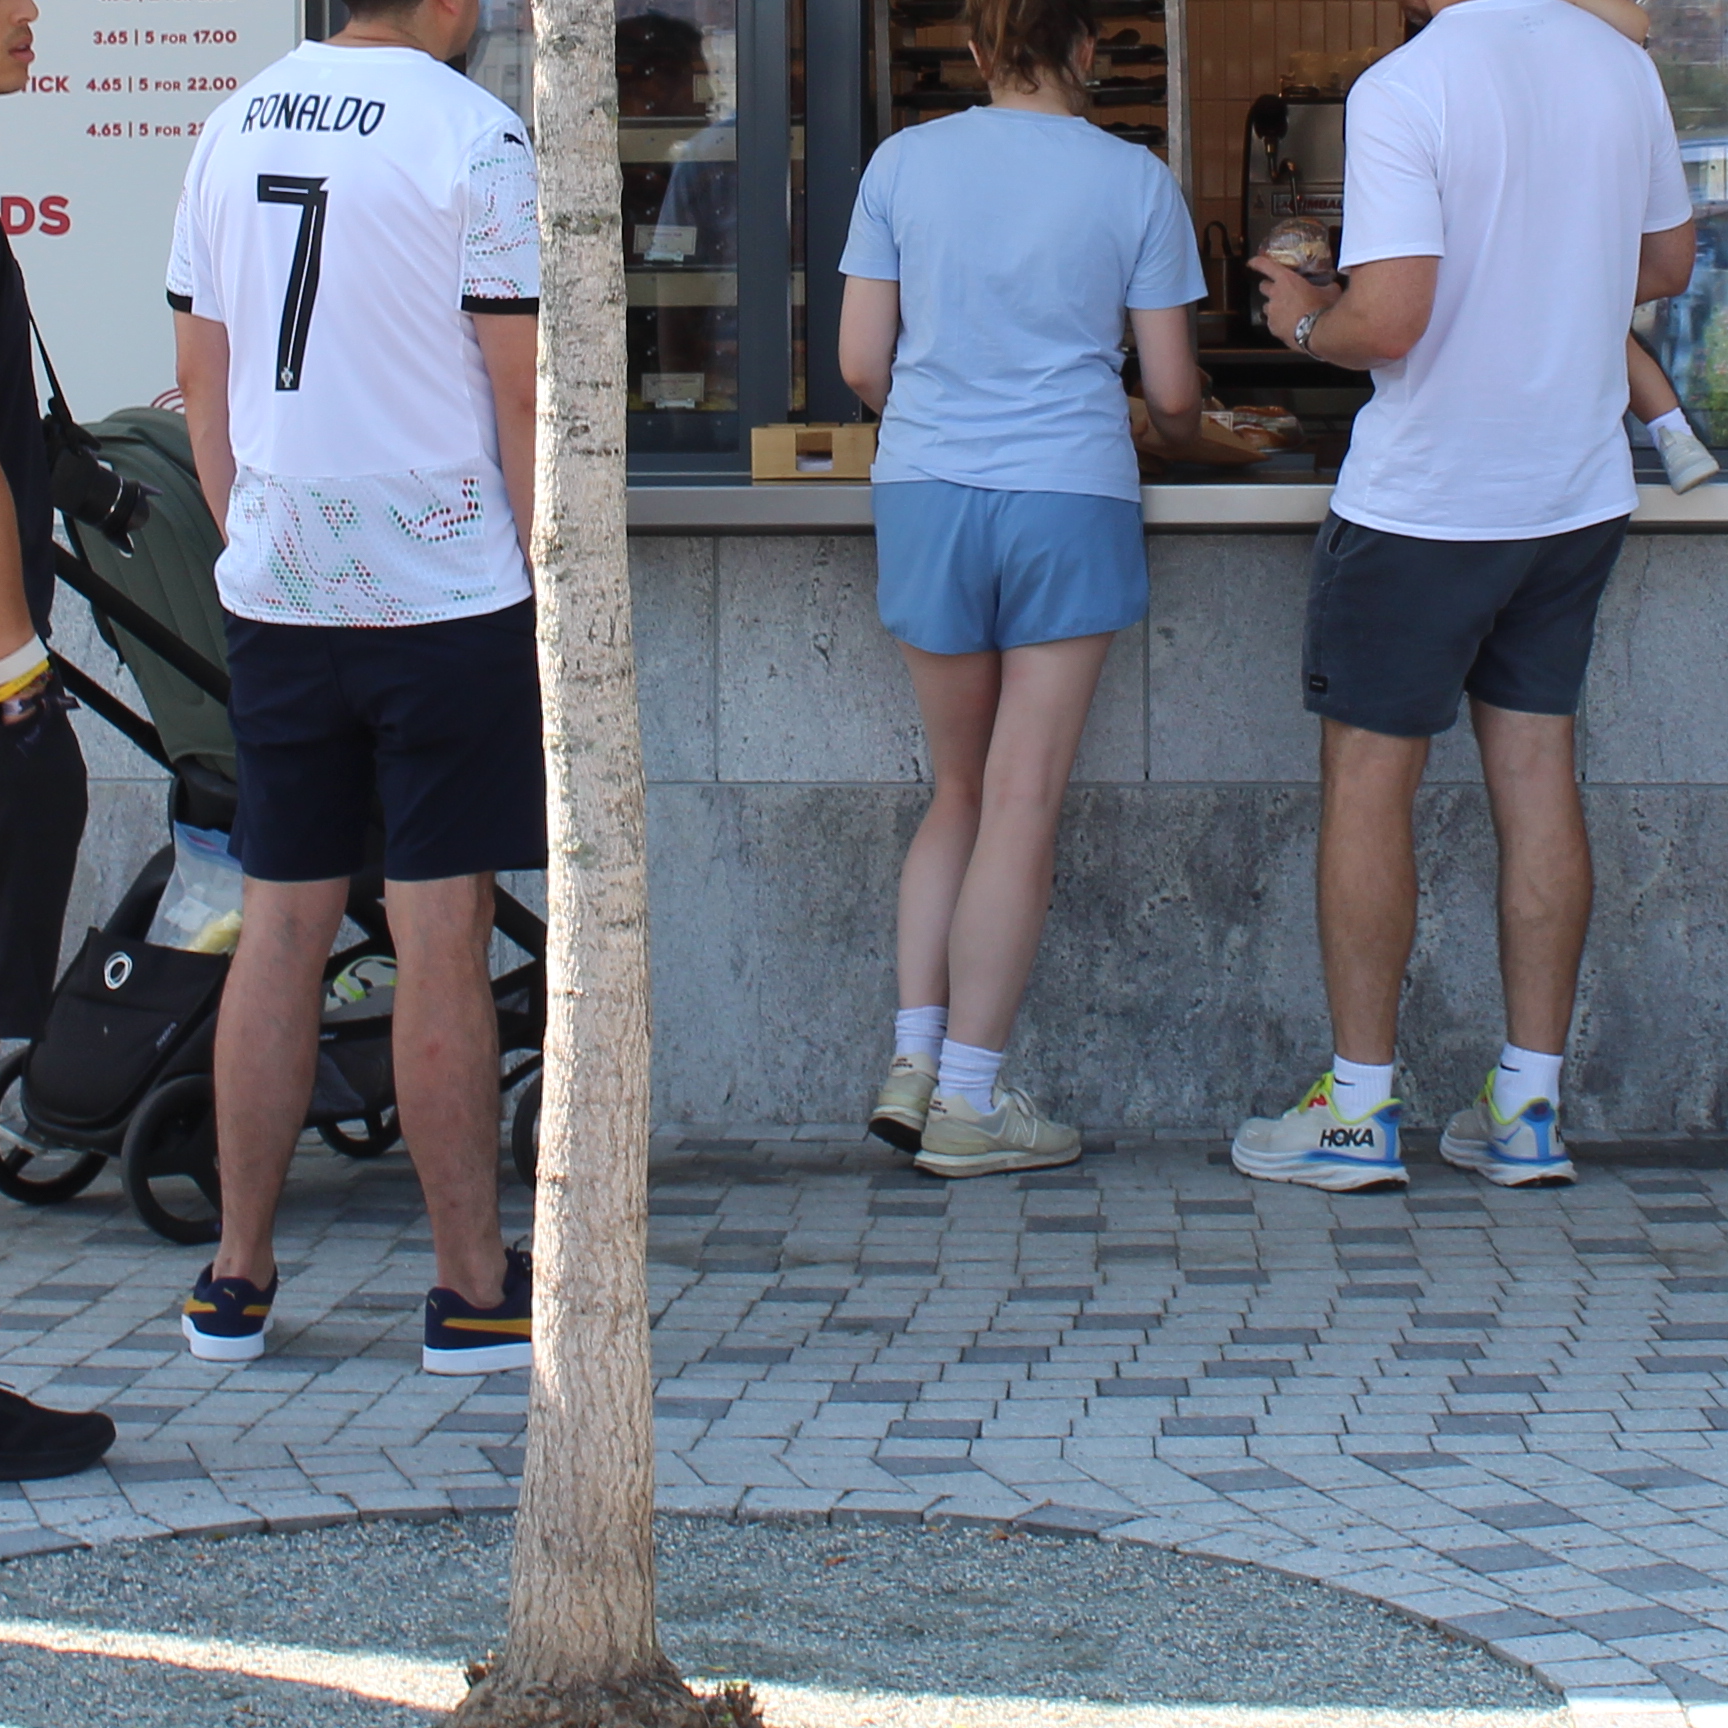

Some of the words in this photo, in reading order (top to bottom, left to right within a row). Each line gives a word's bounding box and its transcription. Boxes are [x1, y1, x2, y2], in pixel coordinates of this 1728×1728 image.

[93, 30, 128, 45] 3.65
[145, 30, 155, 45] 5
[160, 33, 187, 44] FOR
[192, 29, 237, 44] 17.00
[86, 77, 122, 92] 4.65
[138, 77, 149, 92] 5
[154, 80, 181, 92] FOR
[187, 76, 238, 91] 22.00
[240, 93, 386, 136] RONALDO
[86, 122, 122, 137] 4.65
[139, 122, 149, 137] 5
[154, 126, 181, 137] FOR
[256, 174, 329, 391] 7
[1319, 1128, 1375, 1148] HOKA
